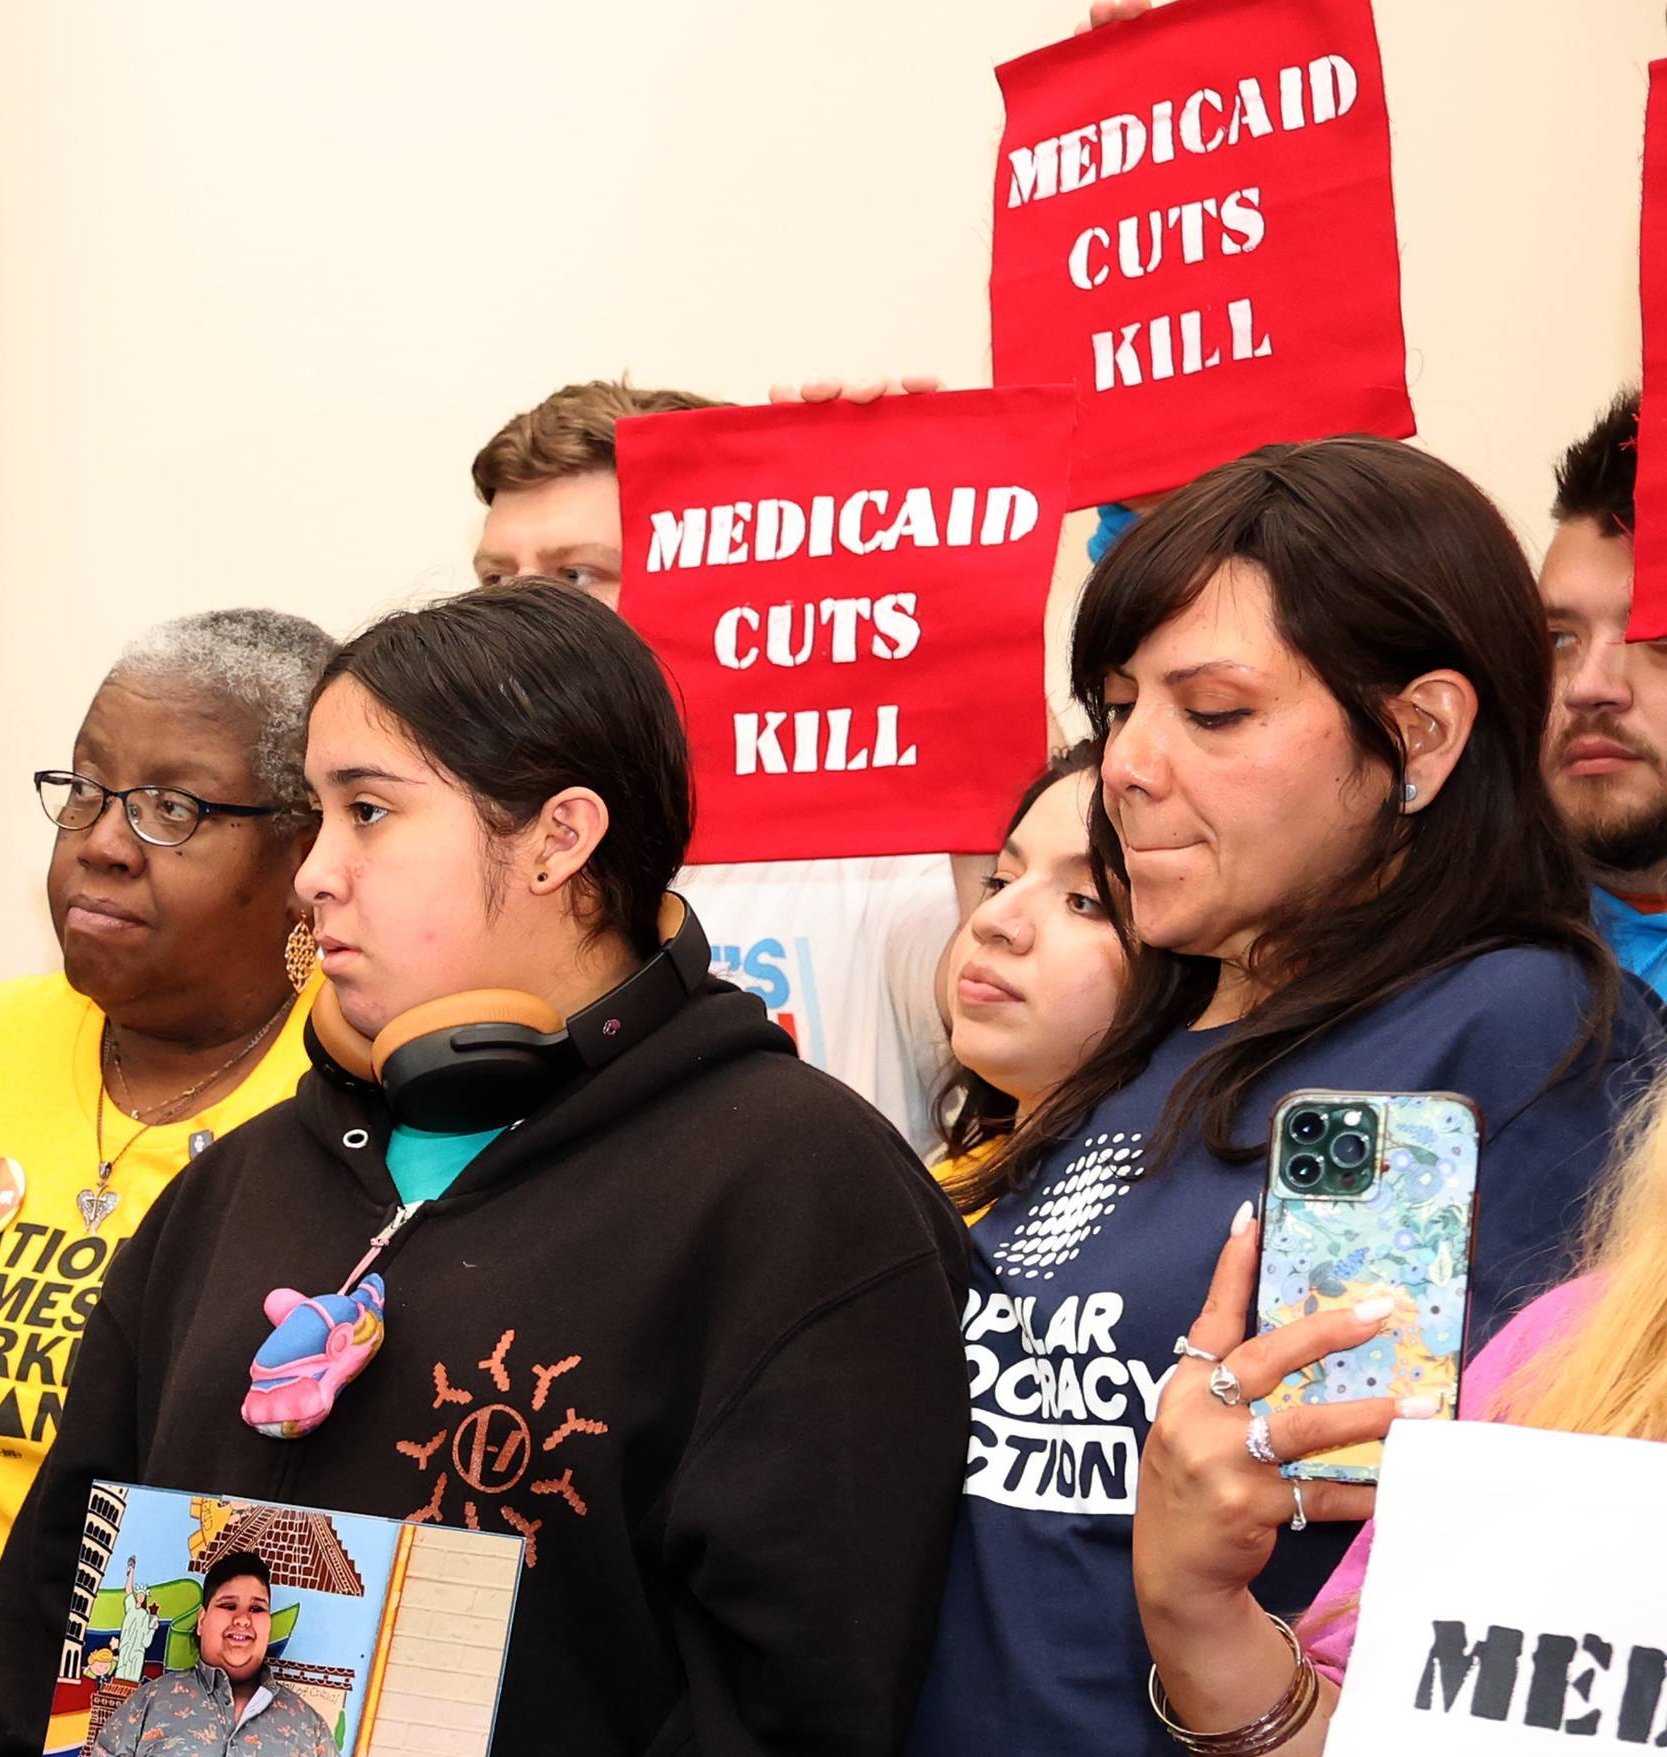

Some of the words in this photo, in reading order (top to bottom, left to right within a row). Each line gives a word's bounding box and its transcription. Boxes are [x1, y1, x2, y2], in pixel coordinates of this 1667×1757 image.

[1007, 54, 1359, 208] MEDICAID
[1068, 189, 1265, 290] CUTS
[1090, 299, 1273, 393] KILL
[646, 485, 1038, 573] MEDICAID
[714, 593, 920, 670] CUTS
[733, 705, 916, 776] KILL
